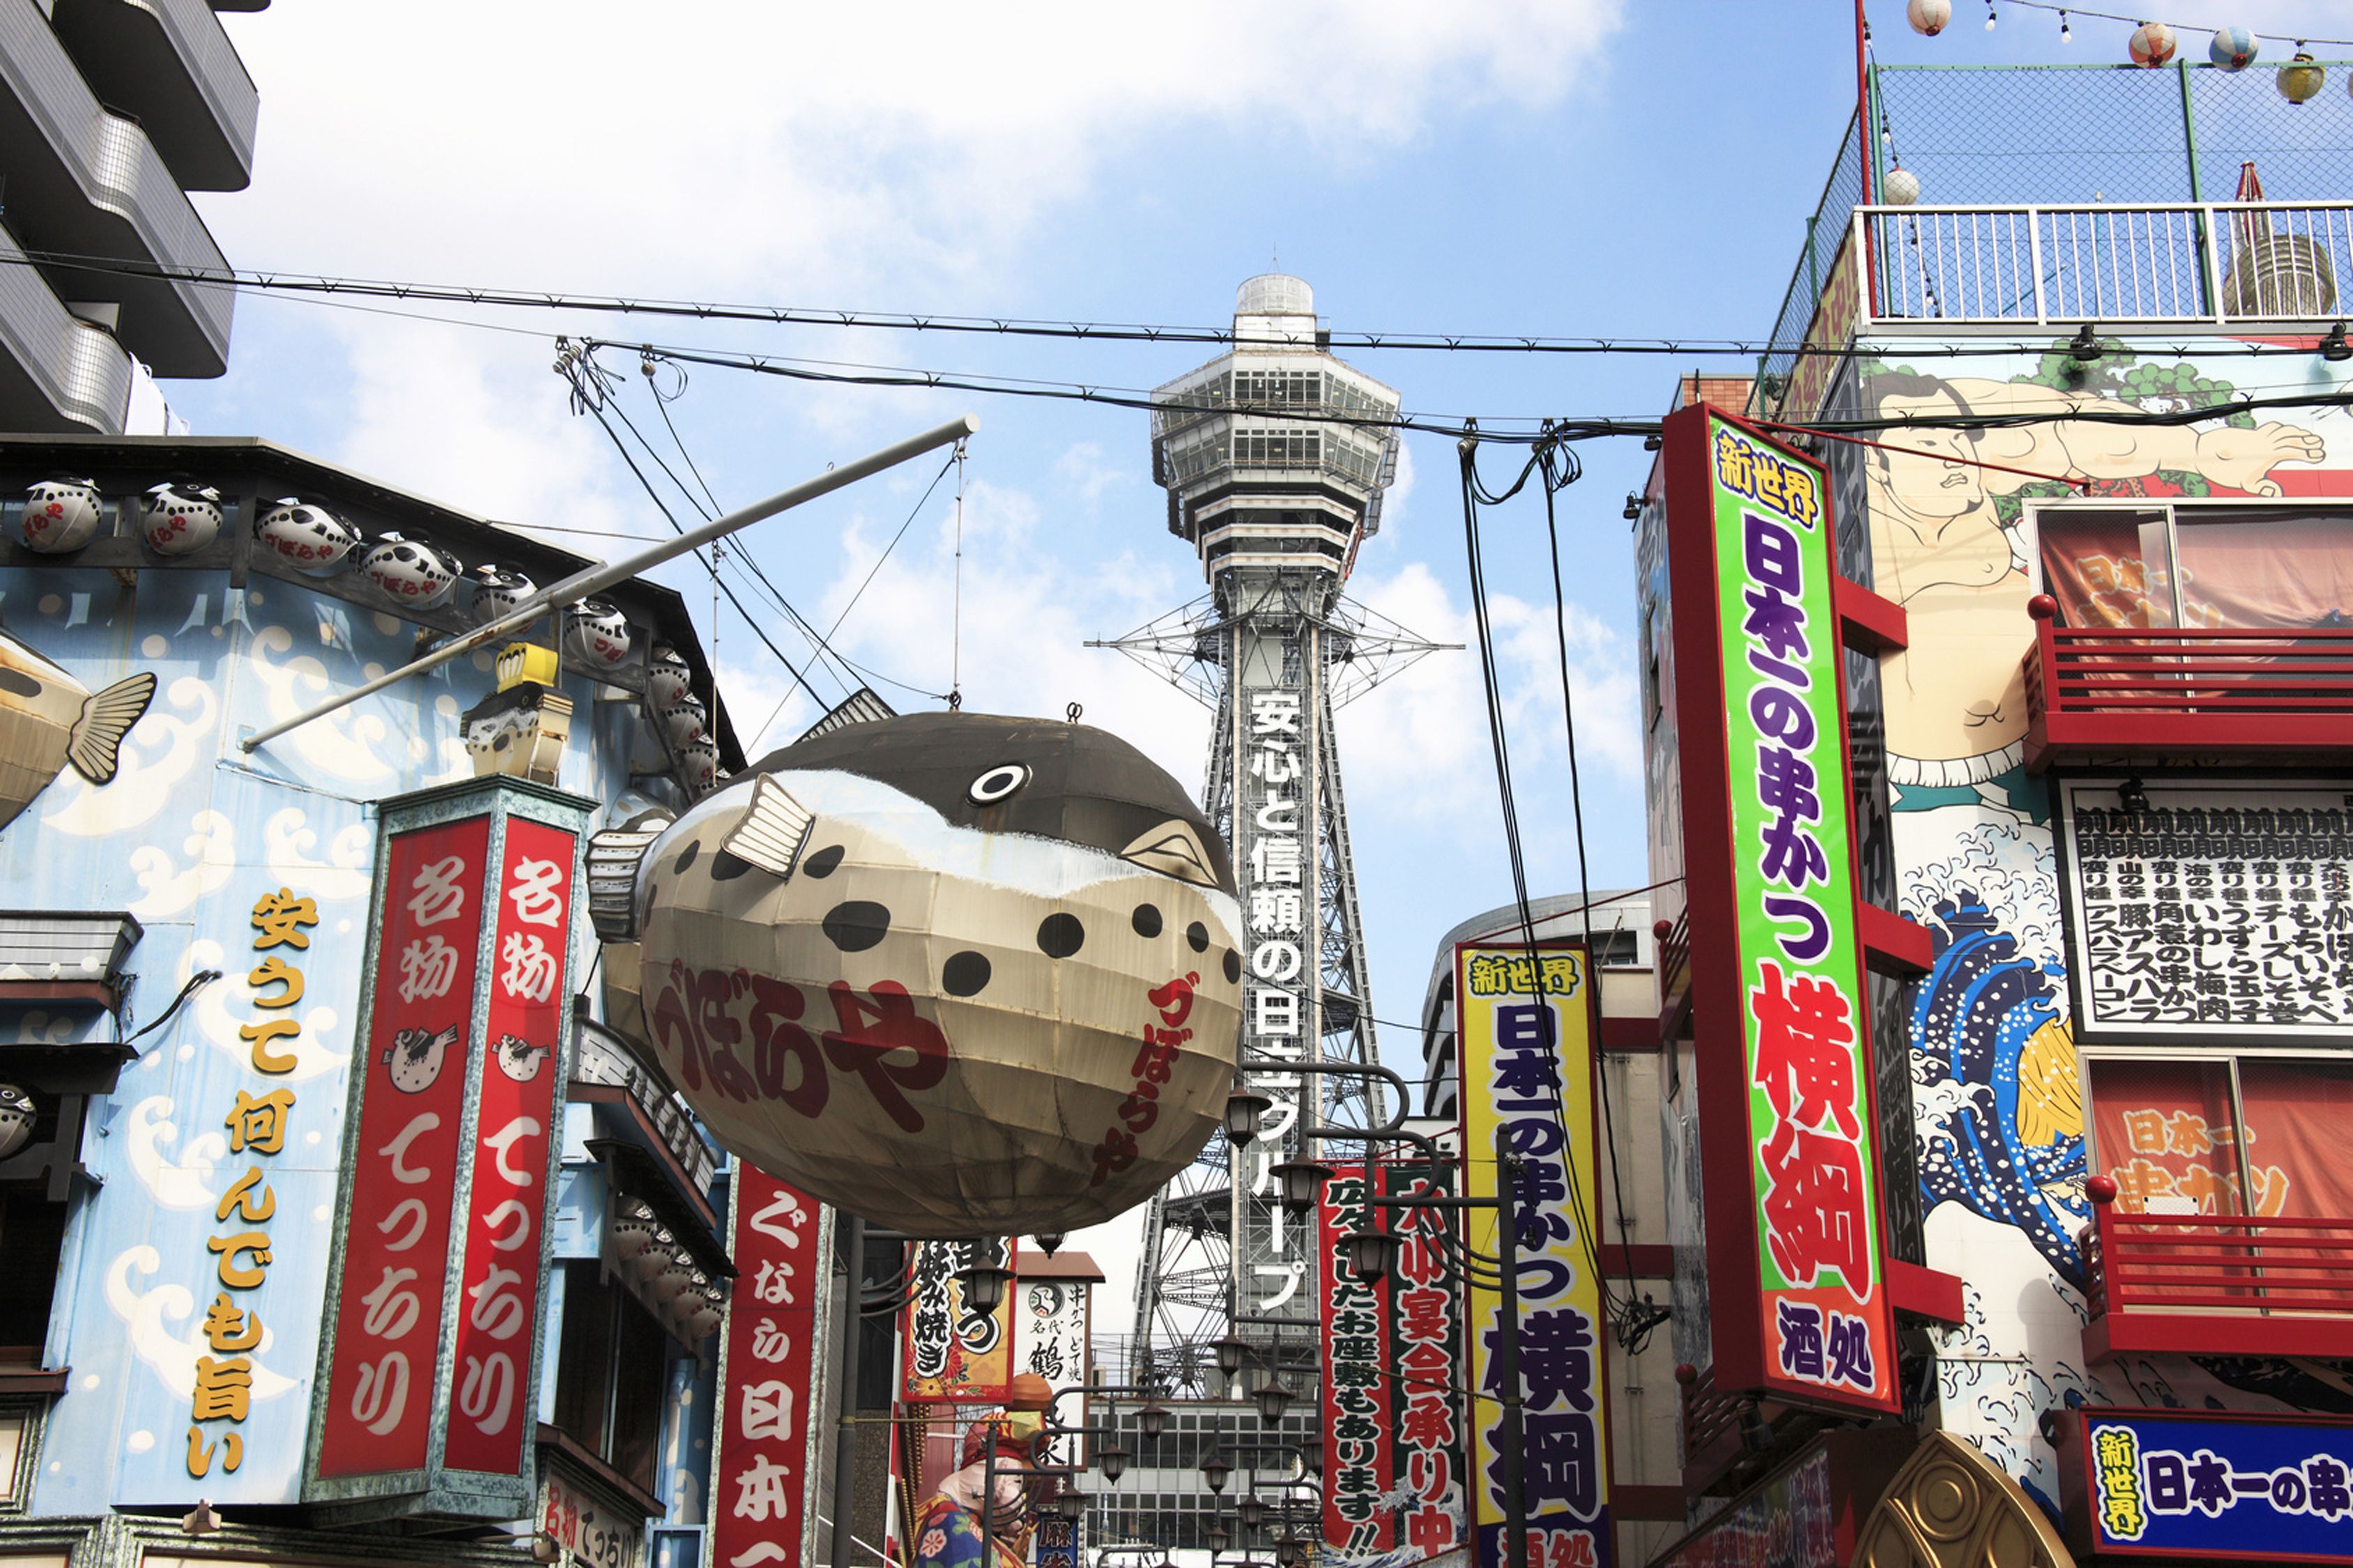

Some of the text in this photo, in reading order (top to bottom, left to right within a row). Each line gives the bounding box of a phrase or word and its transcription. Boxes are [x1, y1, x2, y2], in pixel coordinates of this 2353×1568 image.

[1715, 426, 1818, 527] 新世界
[1471, 956, 1578, 994] 新世界
[2185, 904, 2230, 1022] いわし梅肉
[2222, 902, 2266, 1022] うずら玉子
[654, 958, 949, 1132] づぼらや
[1091, 971, 1200, 1186] づぼらや
[185, 887, 319, 1479] 安うて何んでも旨い
[350, 855, 466, 1435] 名物 てっちり
[460, 855, 563, 1435] 名物 てっちり
[2123, 1108, 2256, 1158] 日本一
[730, 1167, 807, 1568] ぐなら日本一
[1395, 1178, 1455, 1557] 大小宴会承り中
[1778, 1300, 1875, 1391] 酒処
[2098, 1430, 2144, 1536] 新世界
[2147, 1454, 2353, 1516] 日本一の串
